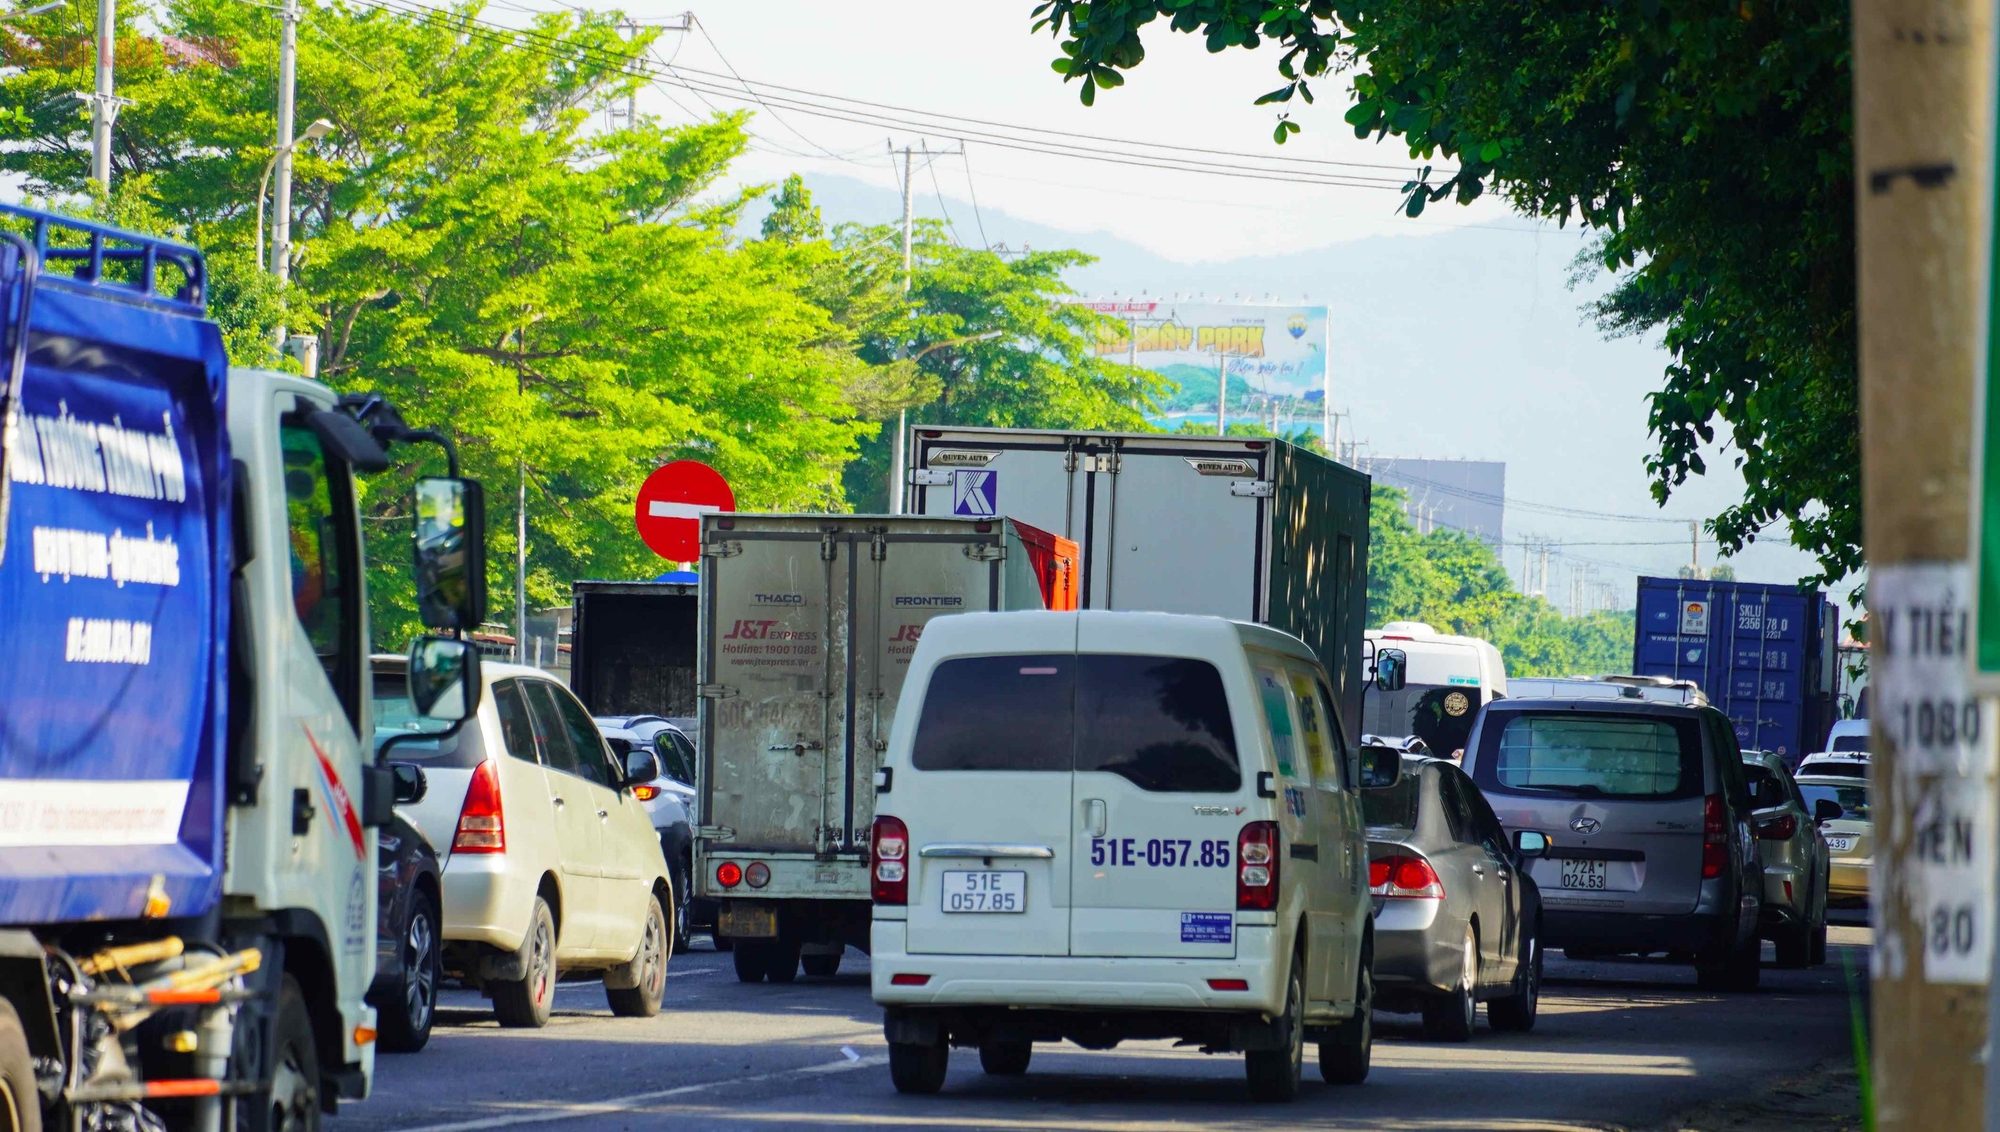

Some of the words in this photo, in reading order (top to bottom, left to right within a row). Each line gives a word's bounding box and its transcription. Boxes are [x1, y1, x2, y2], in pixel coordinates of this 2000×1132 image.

[1197, 326, 1265, 357] PARK
[755, 594, 802, 603] THACO
[895, 597, 962, 606] FRONTIER
[1739, 604, 1761, 617] SKLU
[724, 620, 779, 639] J&T
[770, 631, 818, 640] EXPRESS
[1738, 617, 1761, 630] 2356
[1766, 618, 1777, 630] 78
[888, 624, 925, 642] J&
[1651, 635, 1707, 644] www.sinkor.co.kr
[722, 644, 763, 654] Hotline:
[765, 645, 790, 654] 1900
[793, 646, 818, 655] 1088
[1901, 699, 1980, 747] 1080
[1091, 839, 1231, 868] 51E-057.85
[1572, 860, 1595, 874] 72A
[966, 874, 1002, 891] 51E
[1563, 875, 1604, 889] 024.53
[951, 893, 1016, 911] 057.85
